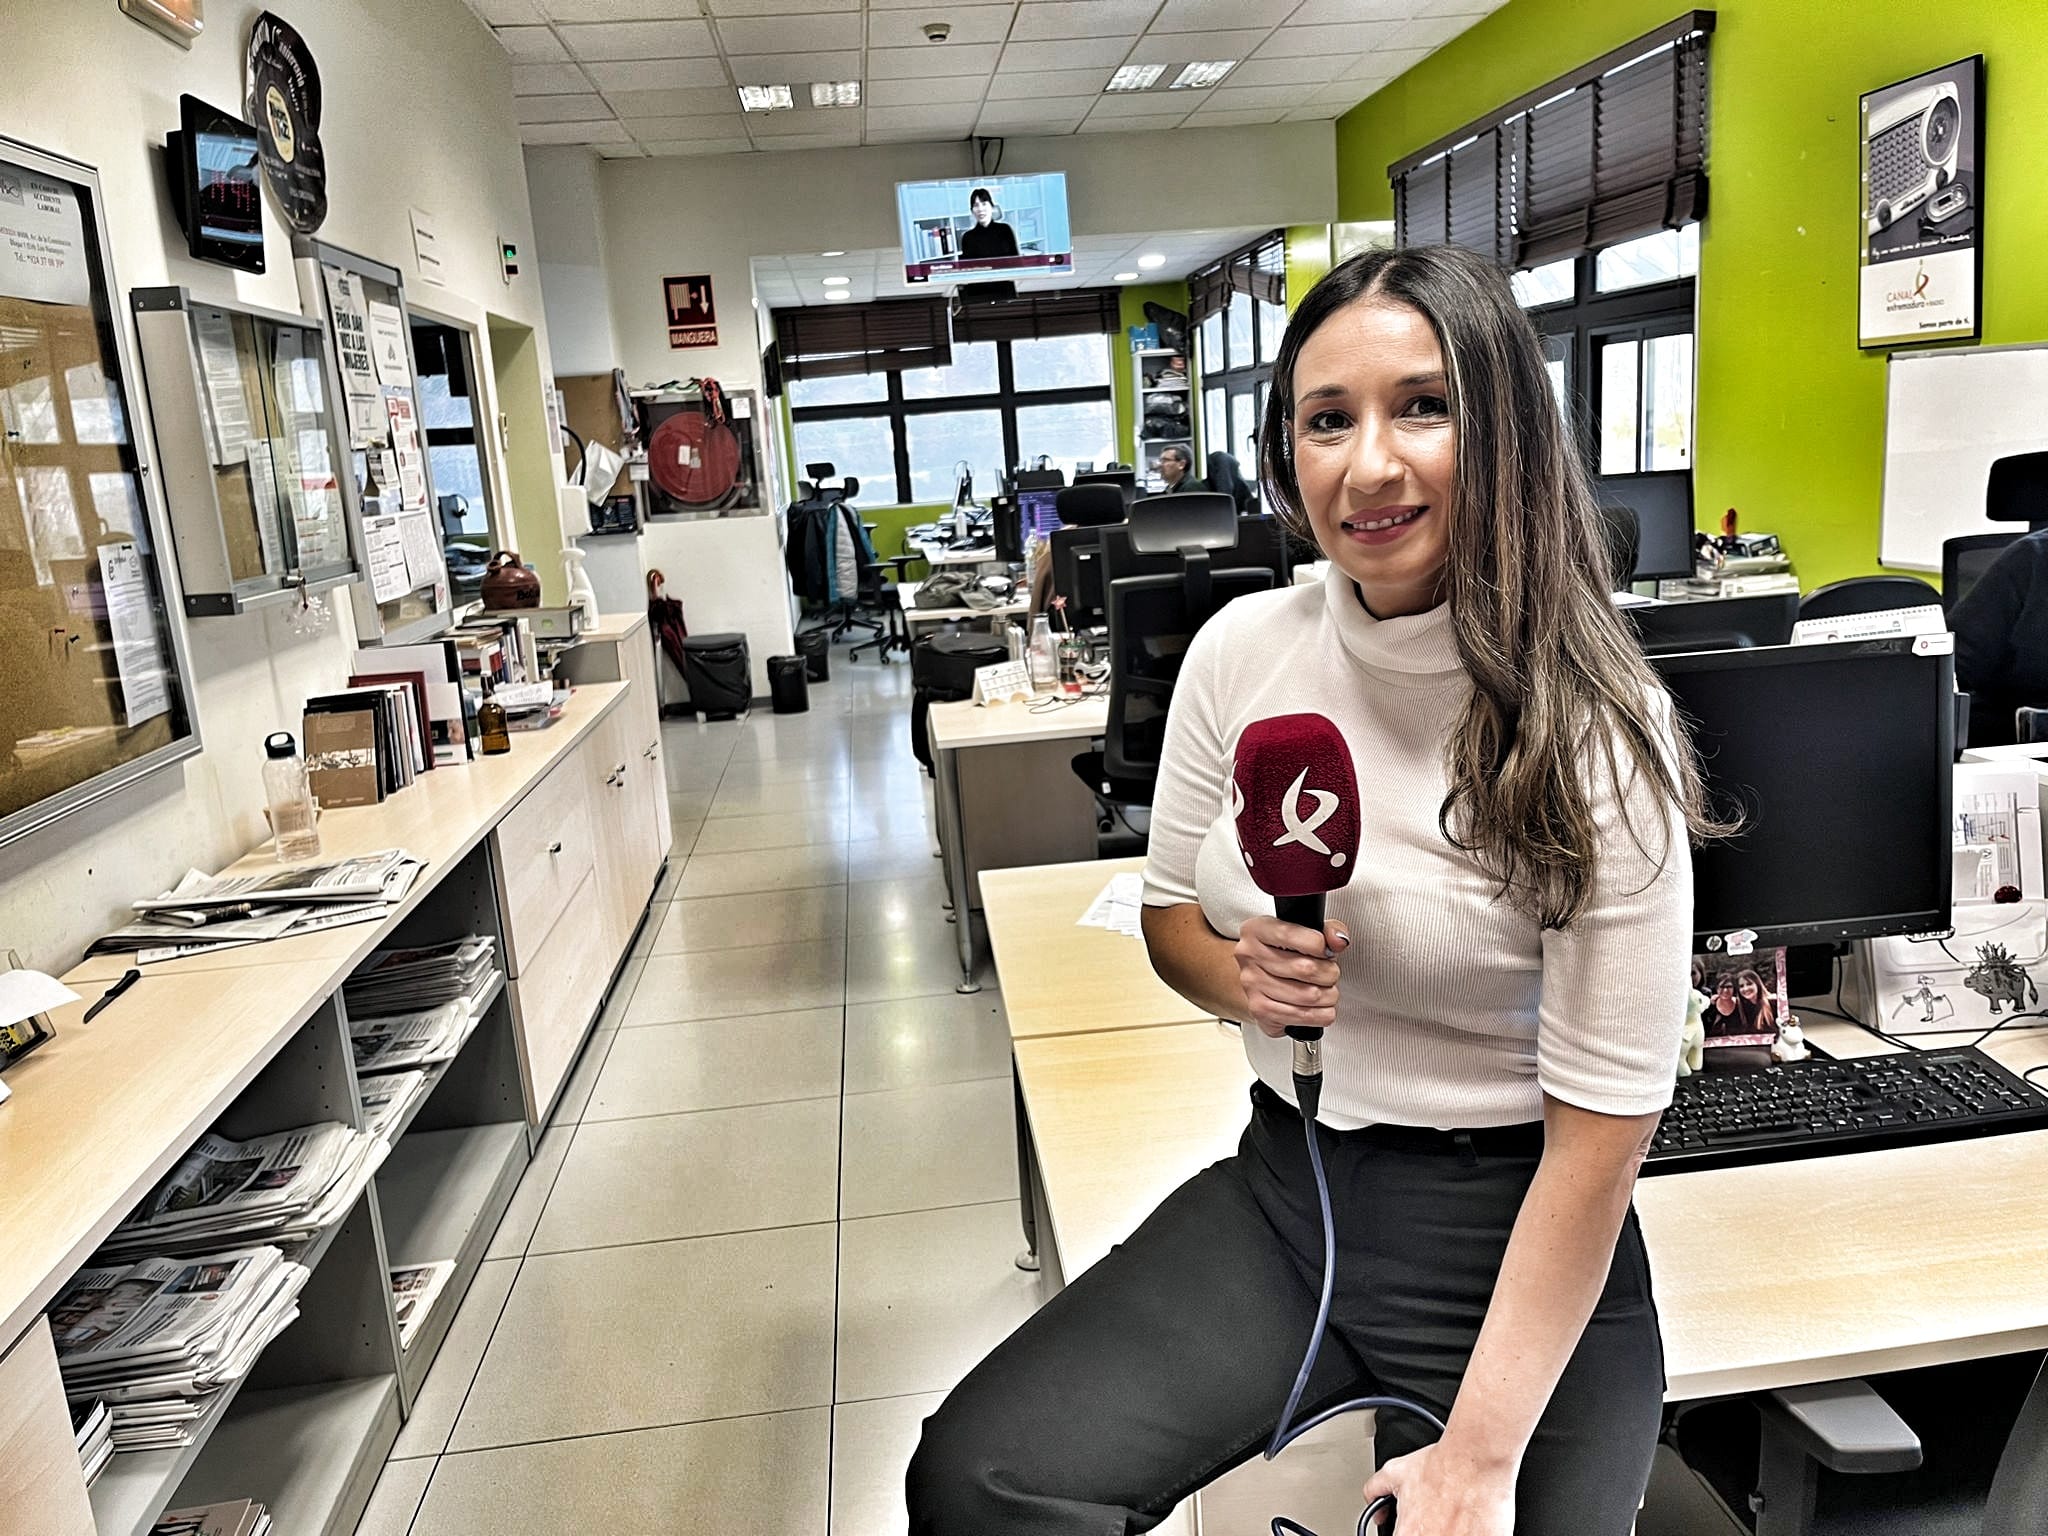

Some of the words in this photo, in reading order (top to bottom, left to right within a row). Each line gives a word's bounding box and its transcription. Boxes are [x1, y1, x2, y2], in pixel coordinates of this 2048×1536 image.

[1886, 290, 1914, 303] CANAL
[1886, 300, 1925, 312] extremadura
[335, 311, 351, 330] PARA
[351, 313, 363, 333] DAR
[671, 330, 715, 344] MANGUERA
[343, 351, 370, 372] MUJERES
